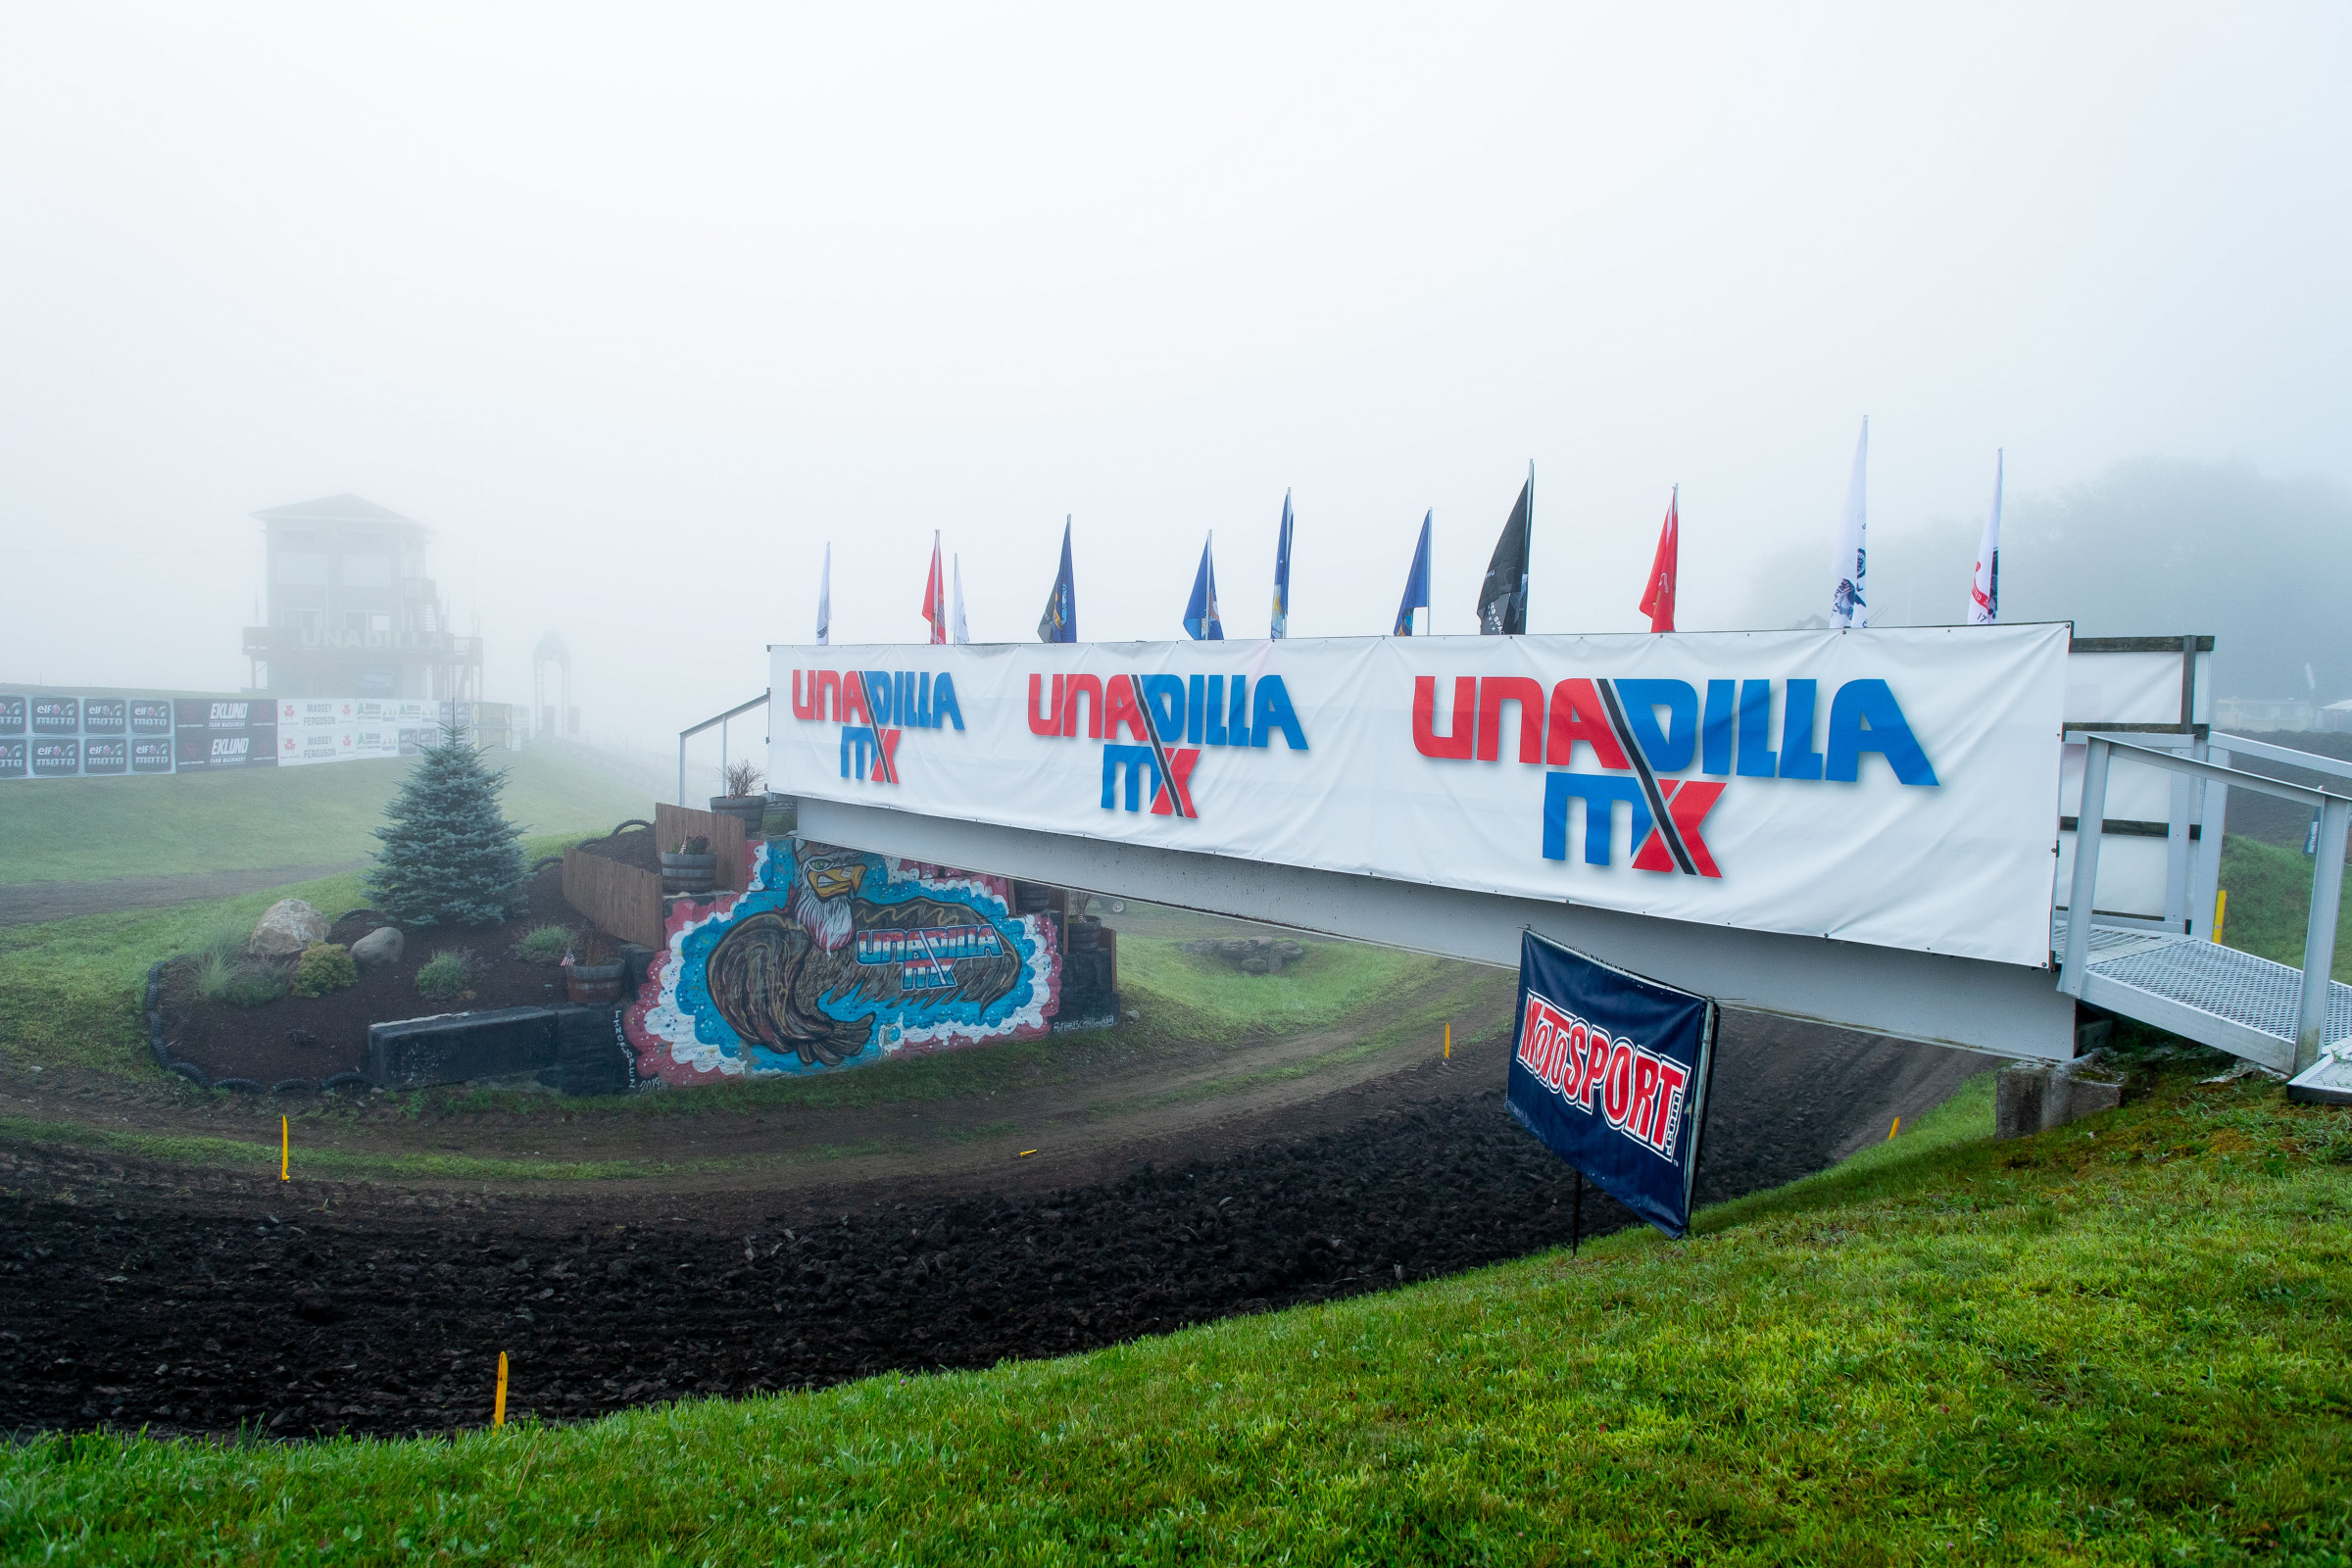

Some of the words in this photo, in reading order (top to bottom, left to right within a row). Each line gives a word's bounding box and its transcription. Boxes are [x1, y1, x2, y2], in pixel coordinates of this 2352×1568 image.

[300, 628, 447, 650] UNADILLA
[792, 668, 966, 731] UNADILLA
[37, 705, 52, 714] elf
[88, 706, 102, 715] elf
[134, 707, 147, 715] elf
[210, 703, 249, 719] EKLUND
[307, 704, 332, 713] MASSEY
[1027, 672, 1309, 752] UNADILLA
[303, 716, 336, 726] FERGUSON
[1412, 675, 1940, 787] UNADILLA
[307, 736, 333, 746] MASSEY
[37, 746, 53, 756] elf
[88, 746, 103, 755] elf
[135, 745, 150, 755] elf
[211, 737, 250, 756] EKLUND
[304, 748, 336, 759] FERGUSON
[856, 924, 1004, 966] UNADILLA
